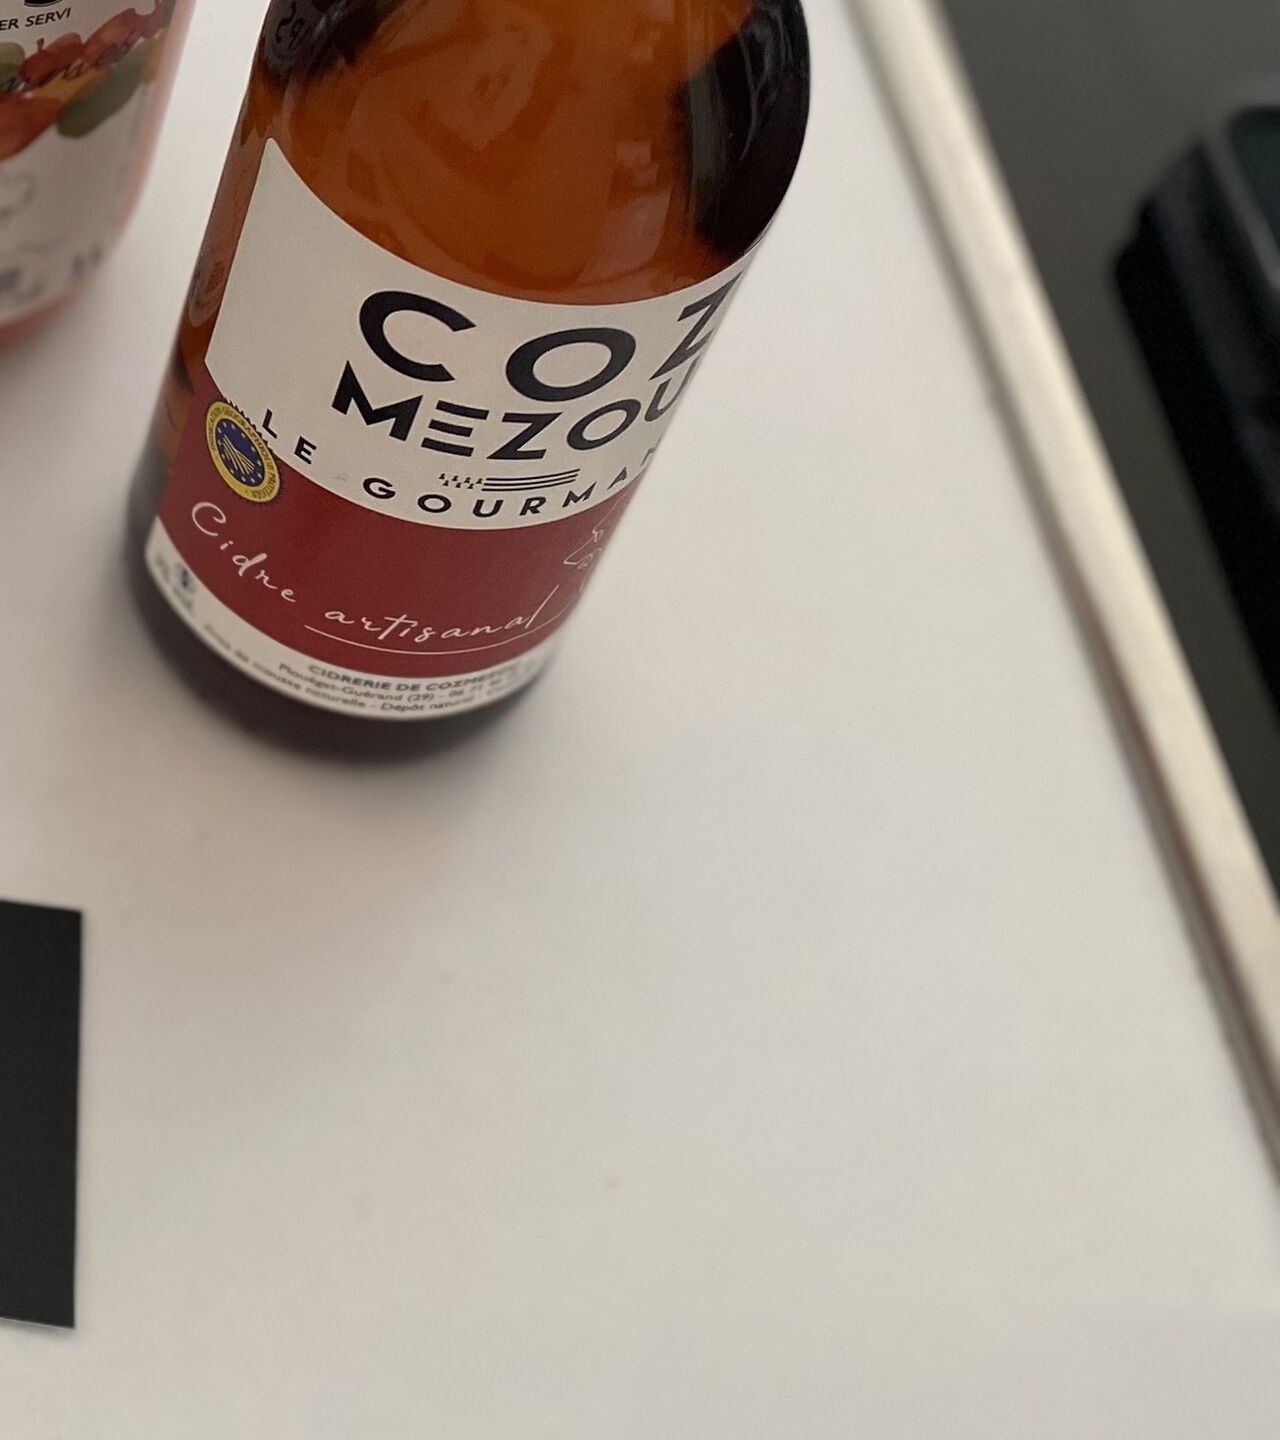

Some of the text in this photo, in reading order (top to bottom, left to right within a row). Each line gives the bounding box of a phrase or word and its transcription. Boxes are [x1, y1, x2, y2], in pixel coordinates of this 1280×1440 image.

[25, 7, 71, 27] SERVI
[358, 270, 742, 403] COZ
[259, 408, 317, 466] LE
[331, 355, 701, 461] MEZOU
[191, 502, 297, 604] Cidre
[324, 584, 559, 643] artisanal
[308, 665, 392, 691] CIDRERIE
[396, 683, 421, 692] DE
